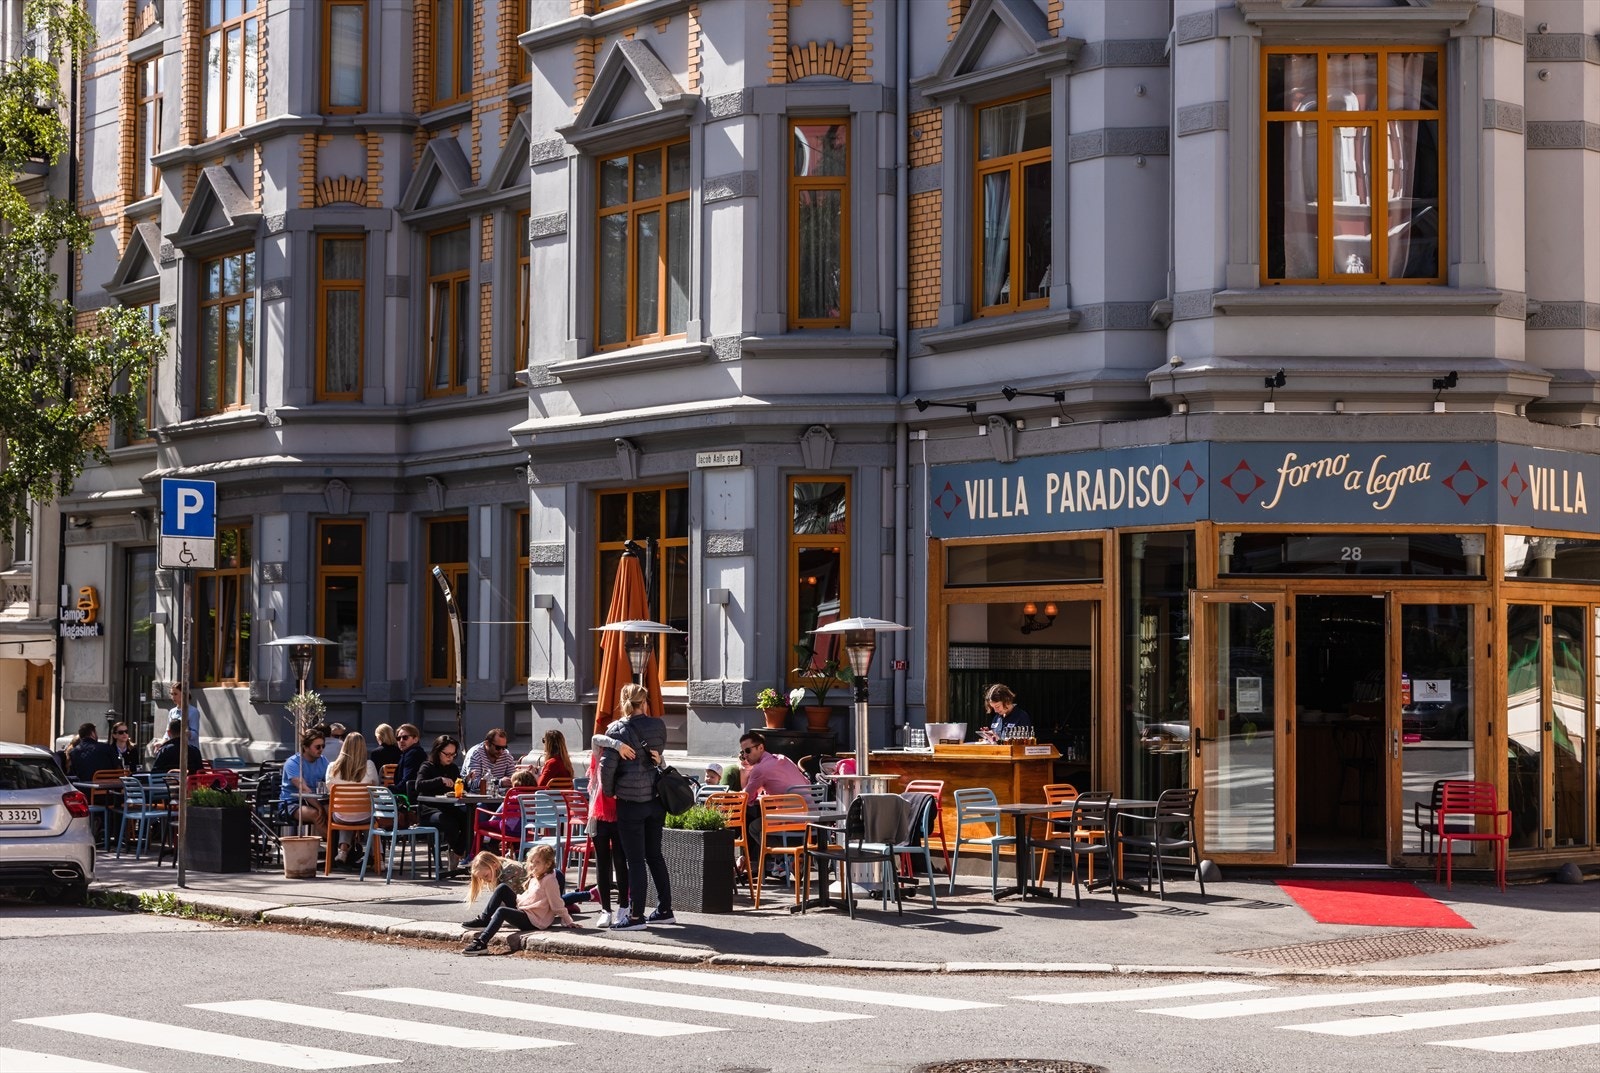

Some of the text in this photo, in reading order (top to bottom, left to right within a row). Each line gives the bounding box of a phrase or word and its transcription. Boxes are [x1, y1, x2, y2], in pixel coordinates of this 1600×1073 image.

[698, 455, 711, 464] Jacob
[727, 453, 738, 464] gate
[1260, 452, 1431, 510] forno a legna
[1528, 464, 1588, 515] VILLA
[965, 464, 1170, 520] VILLA PARADISO
[177, 487, 204, 530] P
[1341, 546, 1362, 561] 28
[60, 606, 85, 623] Lampe
[60, 622, 98, 639] Magasinet
[8, 810, 37, 820] 33219
